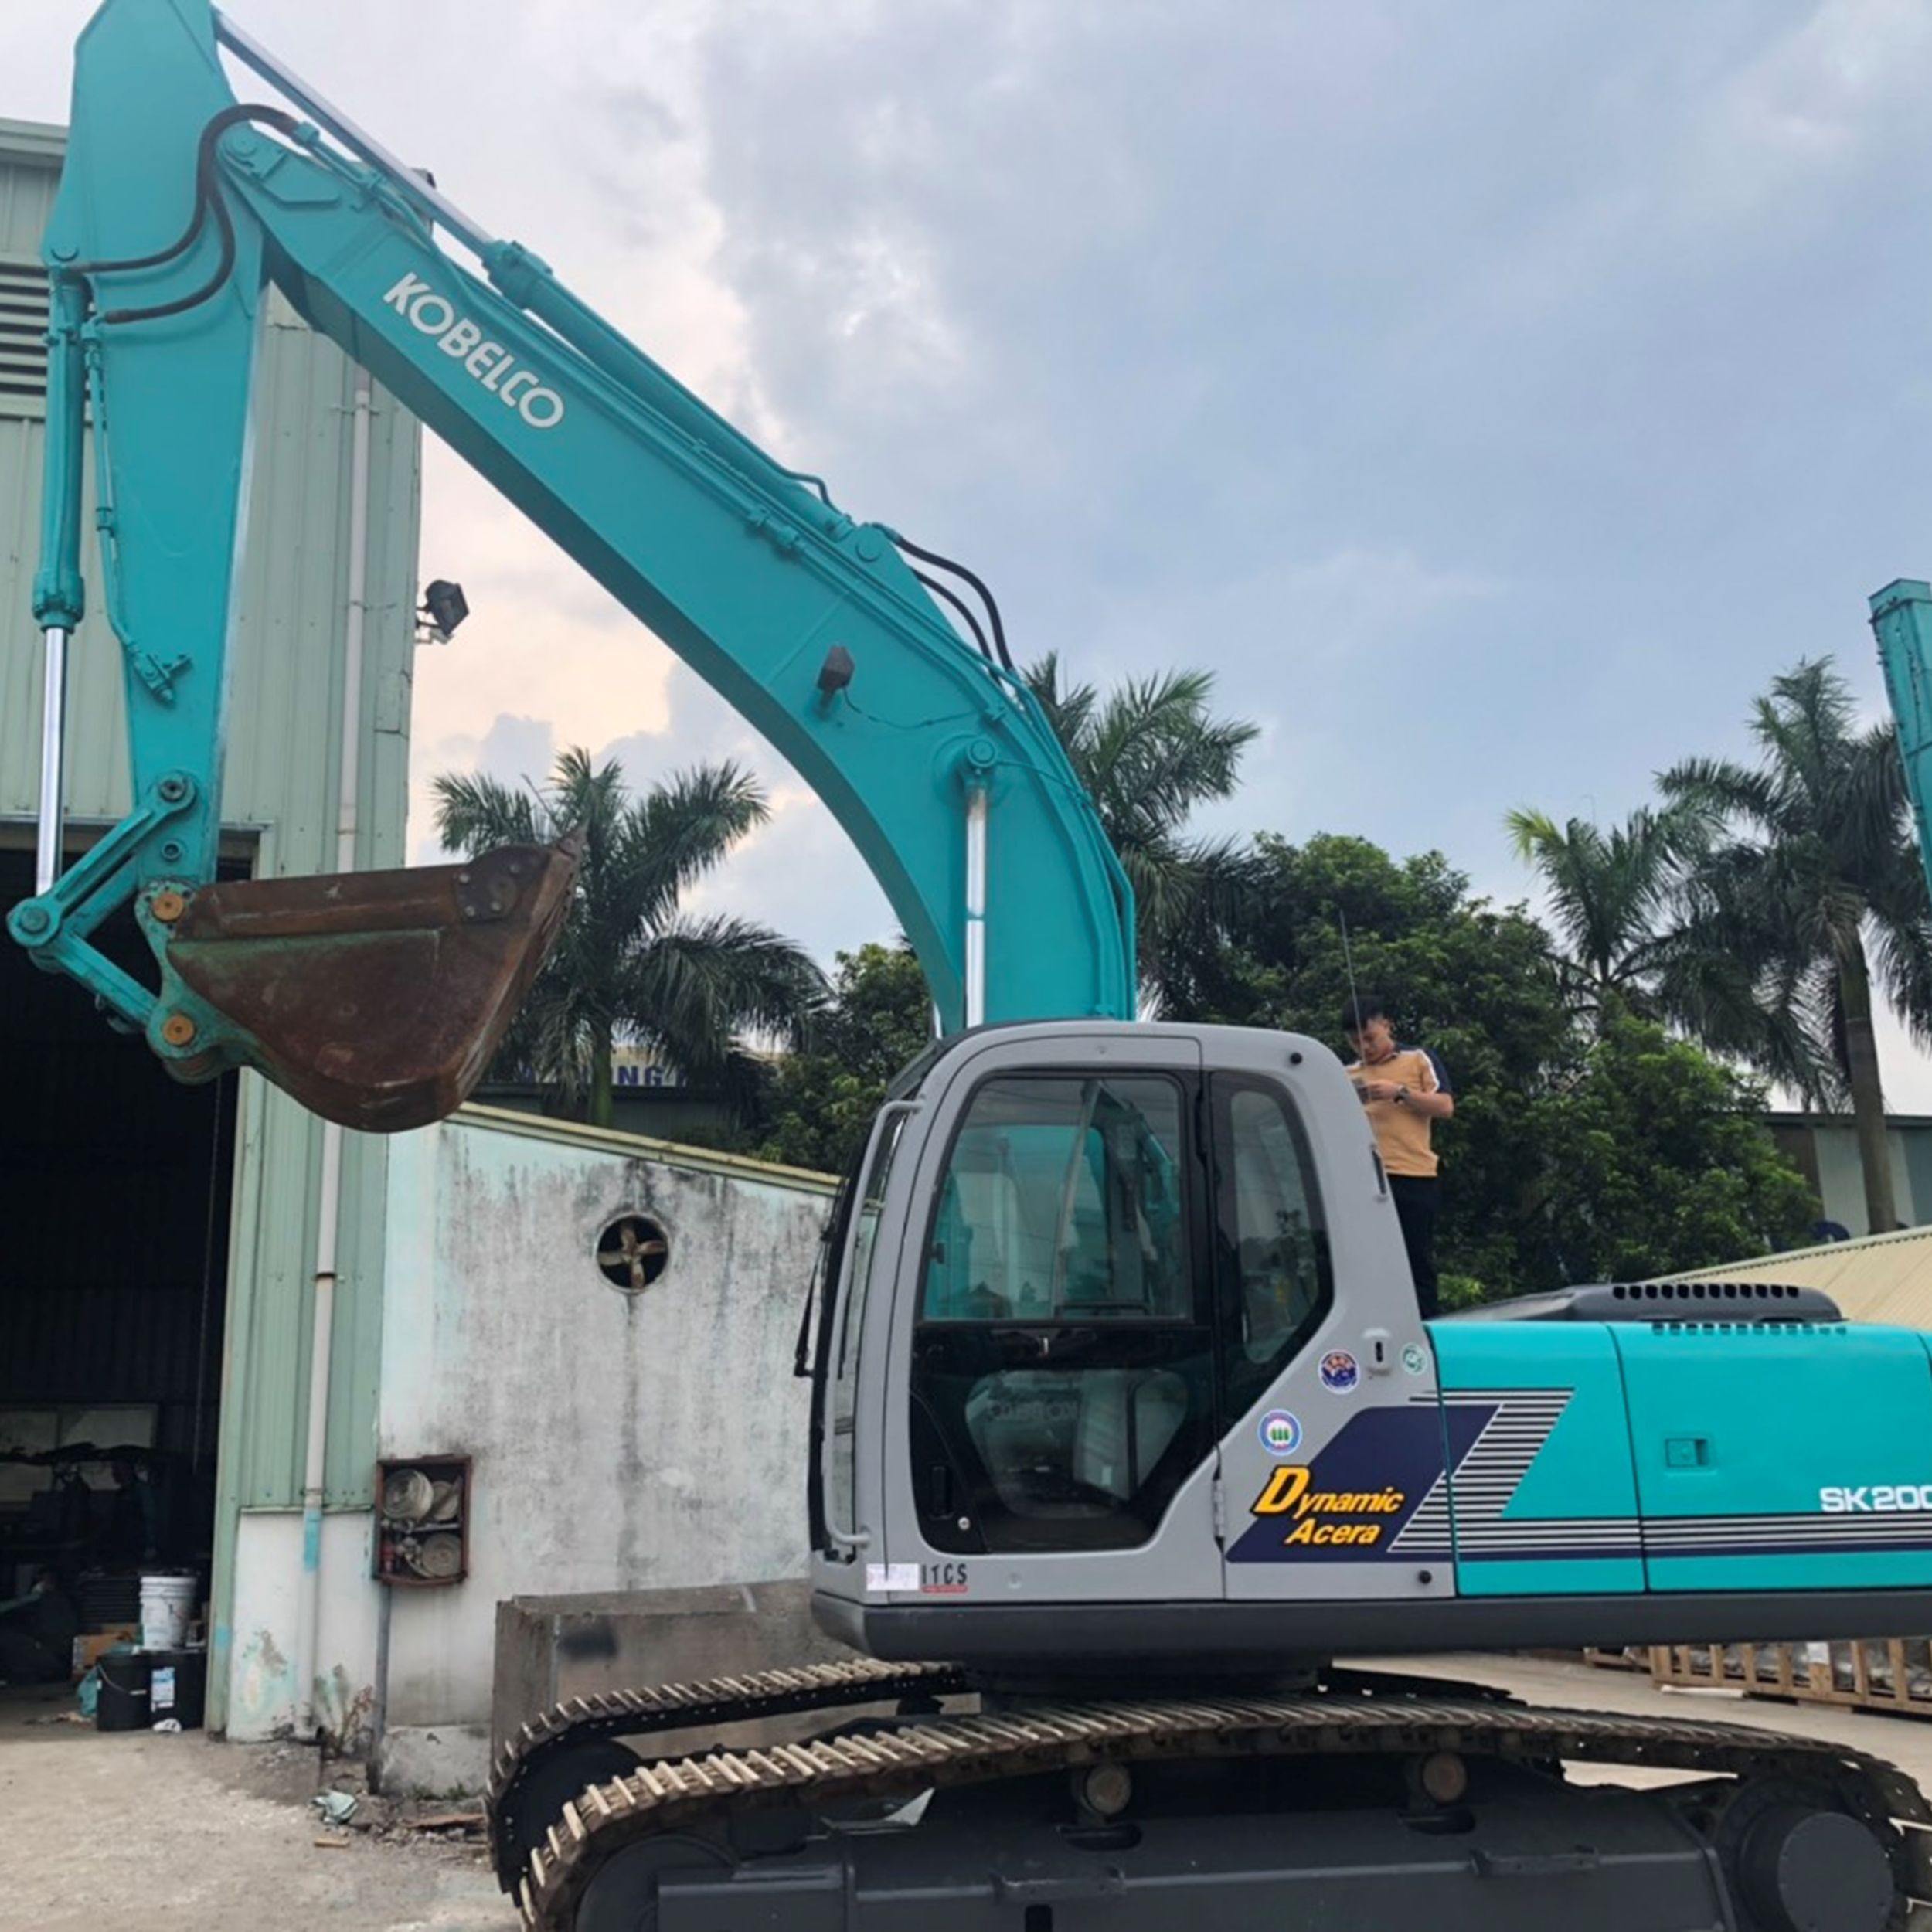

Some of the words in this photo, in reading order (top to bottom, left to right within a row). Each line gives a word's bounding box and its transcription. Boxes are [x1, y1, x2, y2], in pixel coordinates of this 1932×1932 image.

[383, 271, 565, 428] KOBELCO
[1250, 1465, 1405, 1519] Dynamic
[1283, 1517, 1382, 1545] Acera
